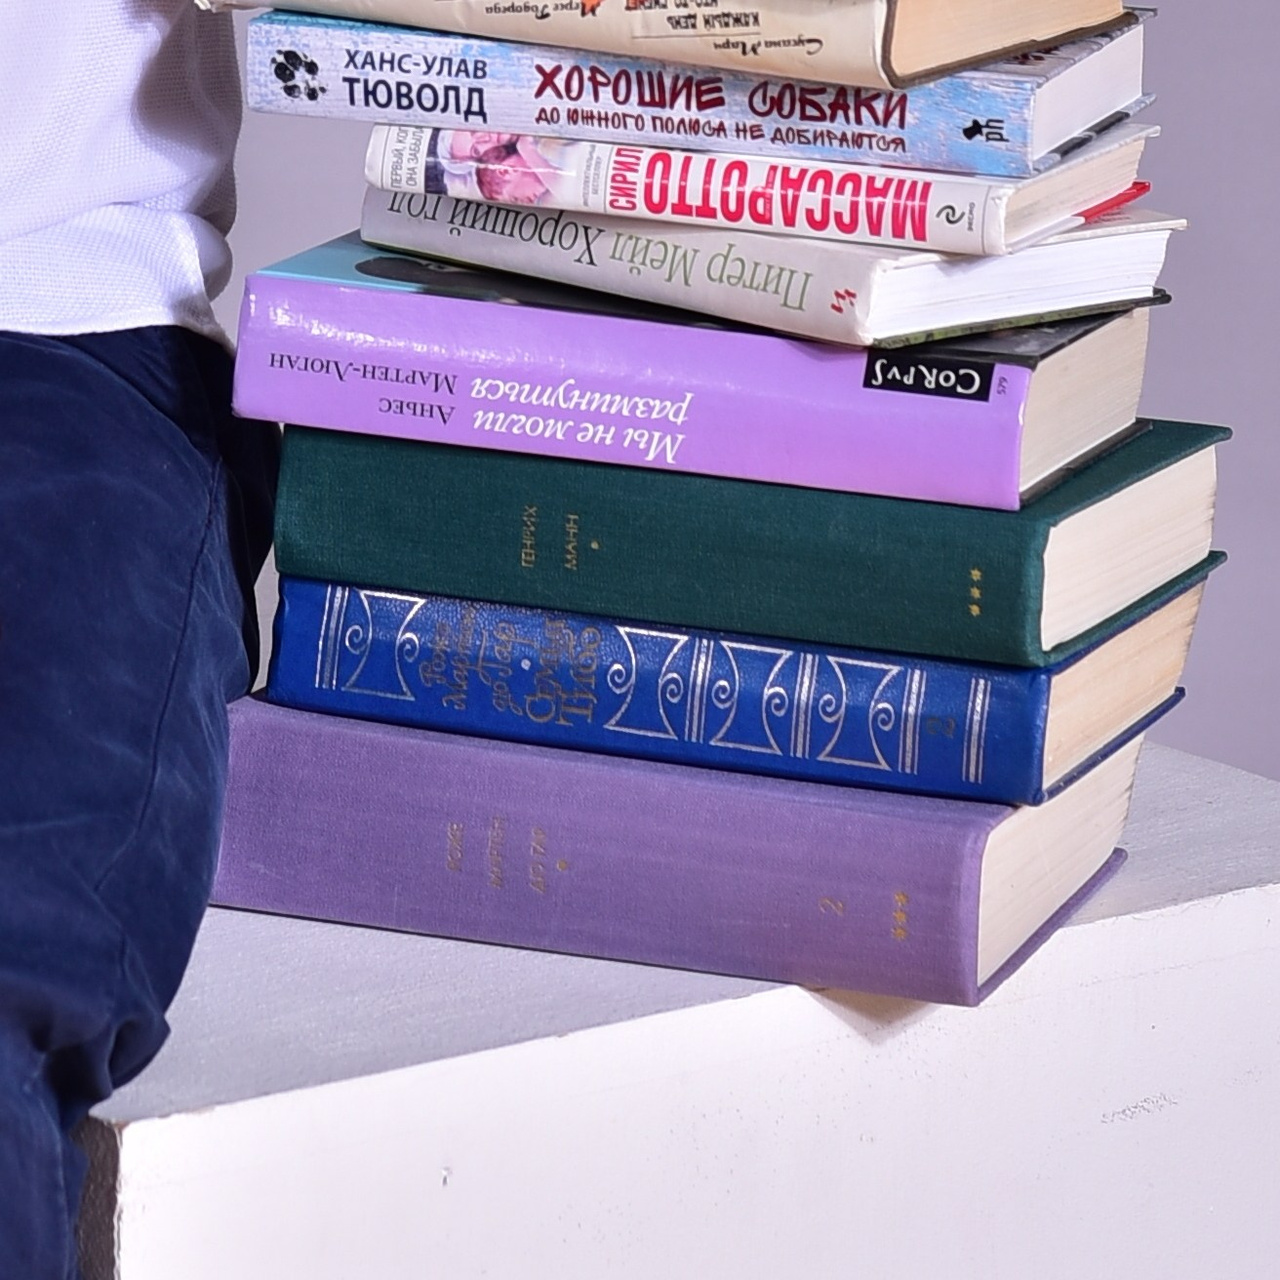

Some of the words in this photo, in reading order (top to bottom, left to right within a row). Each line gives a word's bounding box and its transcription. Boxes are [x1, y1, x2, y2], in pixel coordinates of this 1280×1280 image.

[667, 13, 698, 30] ДЕНЬ
[703, 11, 760, 32] КАЖДЫЙ
[344, 48, 488, 80] ХАНС-УЛАВ
[714, 38, 761, 57] Марч
[764, 34, 824, 56] Сусана
[342, 77, 488, 125] ТЮВОЛД
[534, 63, 726, 111] ХОРОШИЕ
[748, 80, 909, 130] СОБАКИ
[535, 107, 560, 125] ДО
[566, 107, 646, 132] ЮЖНОГО
[651, 116, 727, 140] ПОЛЮСА
[734, 122, 765, 140] НЕ
[771, 126, 907, 153] ДОБИРАЮТСЯ
[390, 147, 406, 188] ПЕРВЫЙ,
[406, 167, 418, 186] ОНА
[609, 147, 644, 211] СИРИЛ
[643, 152, 933, 242] МАССАРОТТО
[449, 199, 605, 266] Хороший
[609, 231, 699, 287] Мейл
[706, 242, 814, 312] Питер
[470, 378, 695, 426] разминуться
[996, 376, 1008, 396] 579
[473, 410, 574, 441] могли
[576, 422, 616, 445] не
[623, 427, 686, 464] Мы
[521, 505, 538, 567] ГЕНРИХ
[564, 514, 579, 571] МАНН
